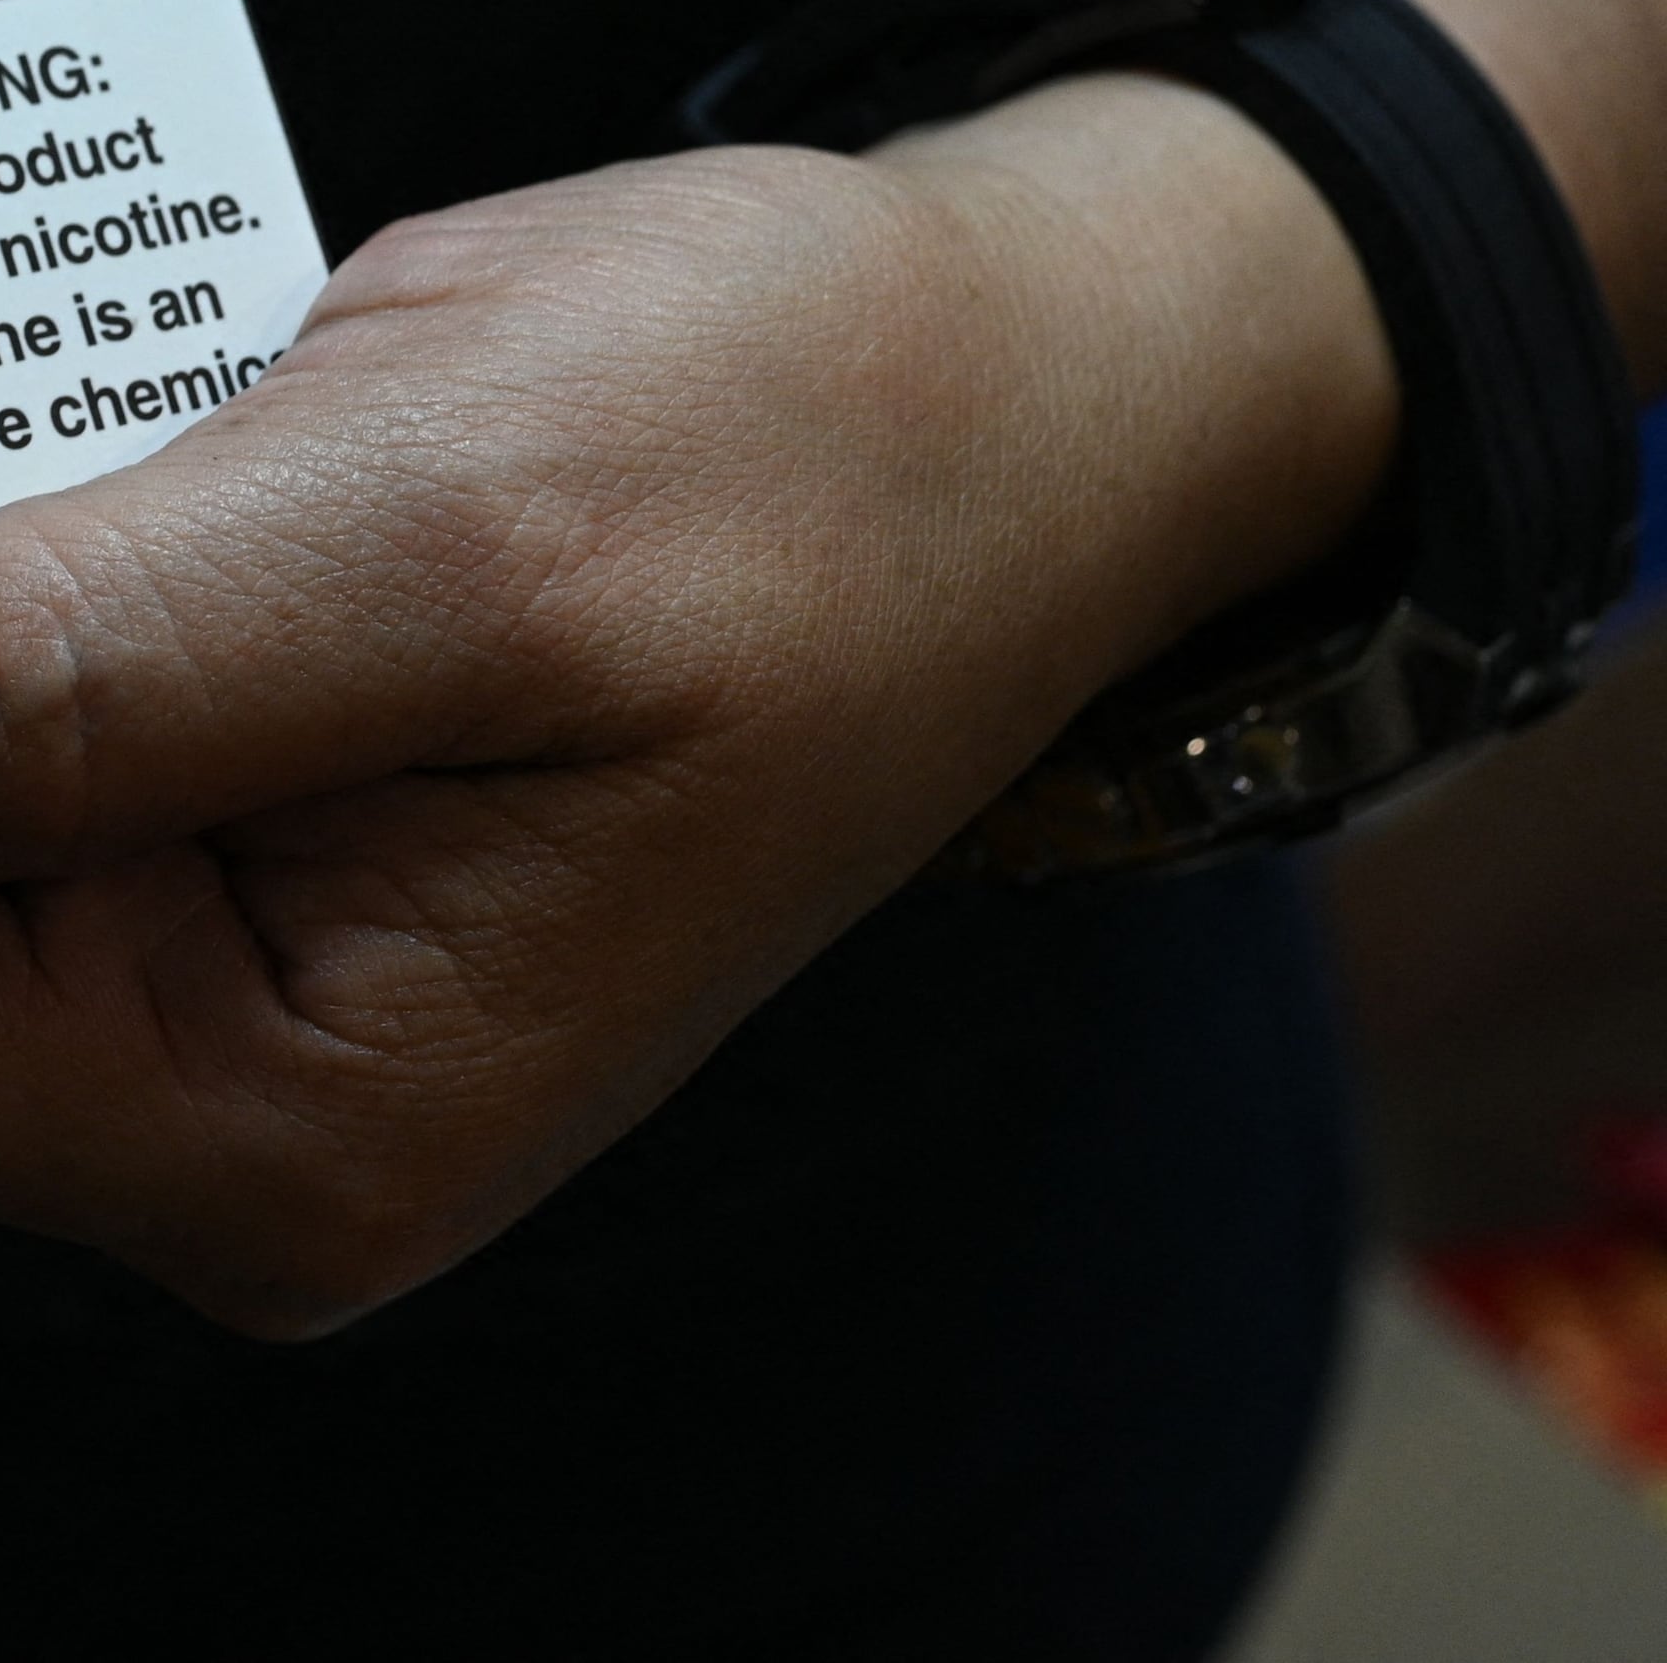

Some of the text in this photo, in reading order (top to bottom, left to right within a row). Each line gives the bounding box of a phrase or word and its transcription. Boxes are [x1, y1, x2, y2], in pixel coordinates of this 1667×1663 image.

[73, 292, 134, 347] is
[148, 278, 226, 333] an
[49, 345, 286, 439] chemic
